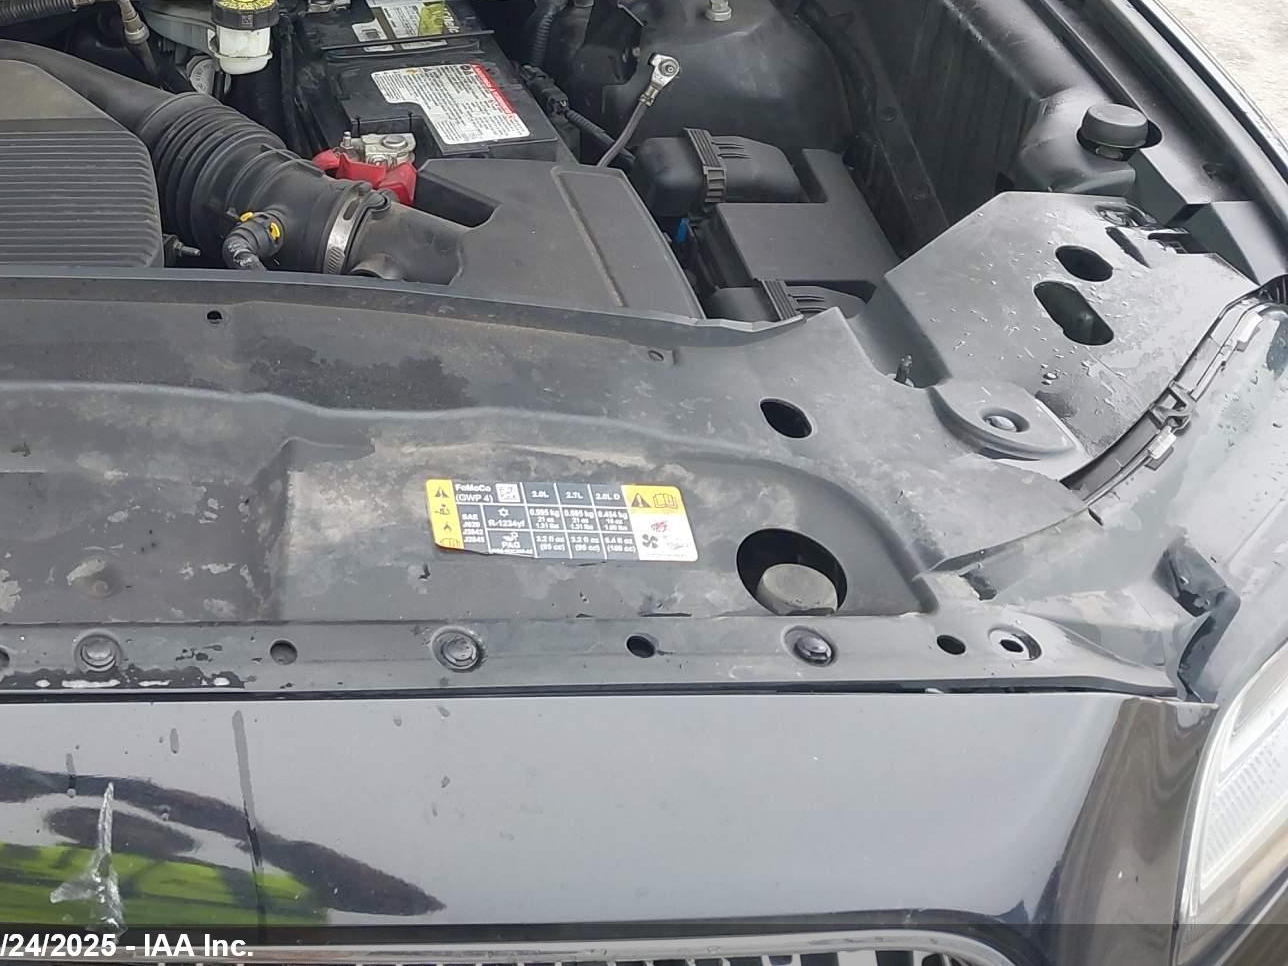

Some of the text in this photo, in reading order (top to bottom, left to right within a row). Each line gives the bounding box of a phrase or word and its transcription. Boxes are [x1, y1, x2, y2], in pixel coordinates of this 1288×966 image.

[455, 483, 492, 493] FoMoCo
[455, 493, 493, 504] (GWP 4)
[487, 519, 526, 529] R-1234yf
[501, 541, 521, 549] PAG
